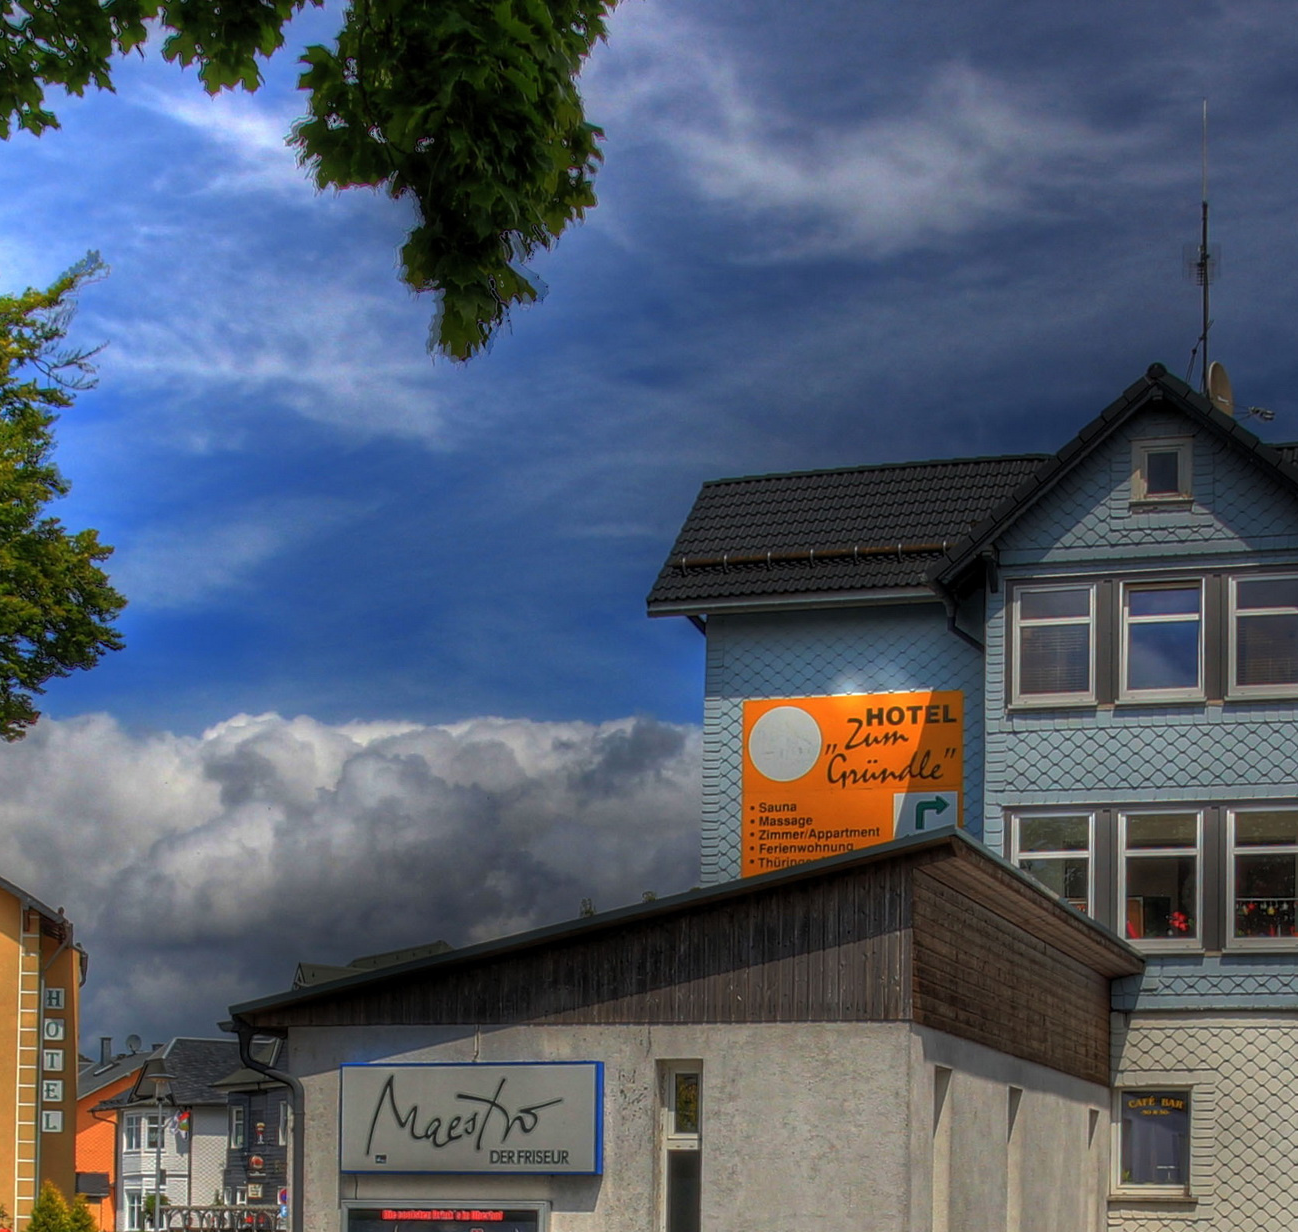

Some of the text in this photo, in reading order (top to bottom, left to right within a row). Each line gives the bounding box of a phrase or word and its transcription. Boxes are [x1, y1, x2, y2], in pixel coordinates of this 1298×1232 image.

[866, 704, 957, 727] HOTEL
[759, 802, 797, 813] Sauna
[759, 816, 813, 828] Massage
[759, 827, 880, 841] Zimmer/Appartment
[759, 842, 854, 854] Ferienwohnung
[44, 989, 63, 1131] HOTEL
[1161, 1097, 1184, 1110] BAR
[366, 1074, 564, 1156] Maestro
[490, 1150, 569, 1165] DER FRISEUR
